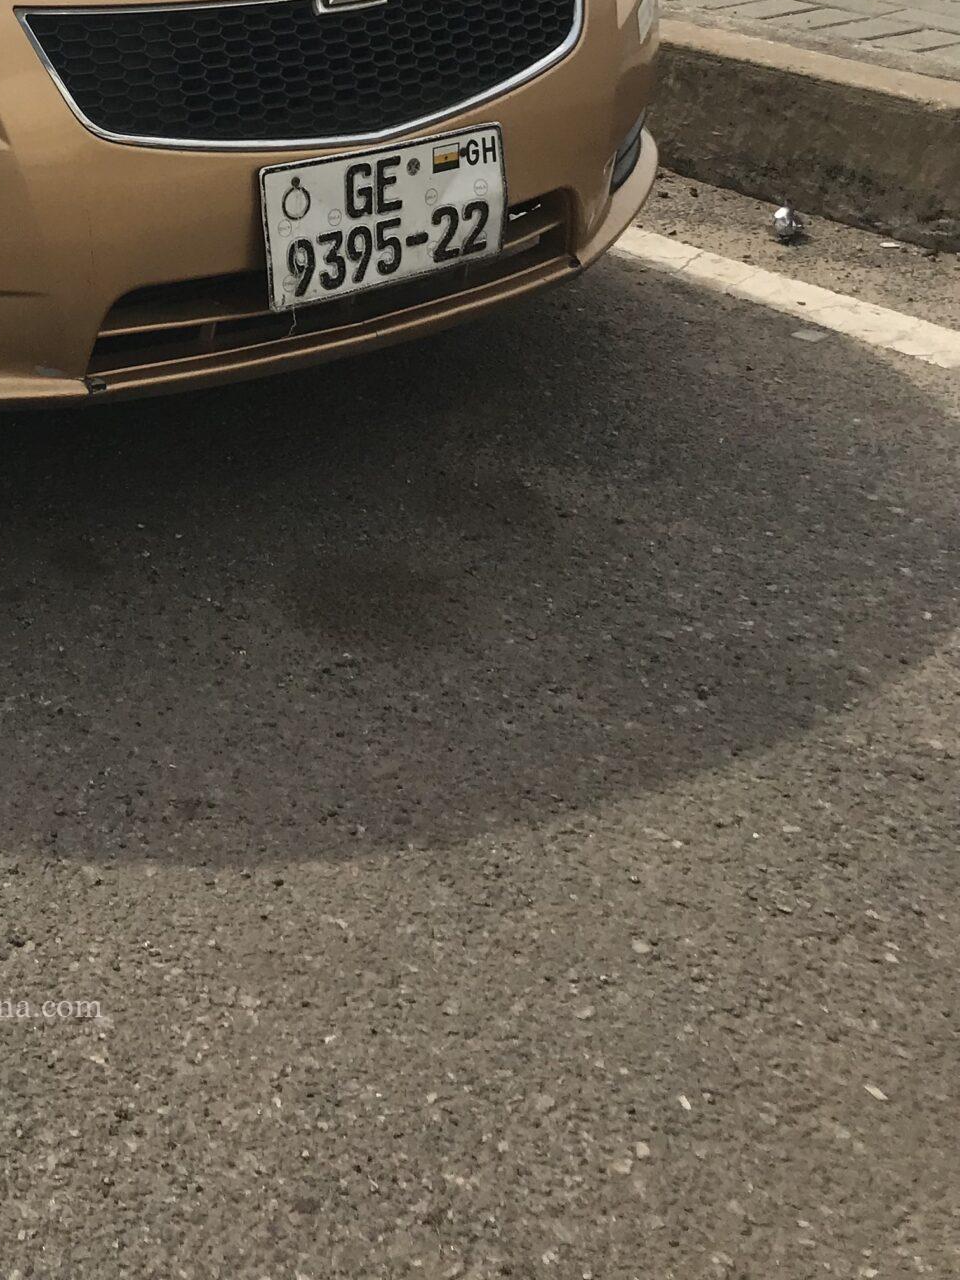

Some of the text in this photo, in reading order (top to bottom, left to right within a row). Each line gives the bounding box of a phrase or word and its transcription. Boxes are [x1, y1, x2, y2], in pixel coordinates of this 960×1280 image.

[465, 135, 498, 166] GH
[344, 155, 403, 219] GE
[286, 200, 490, 297] 9395-22
